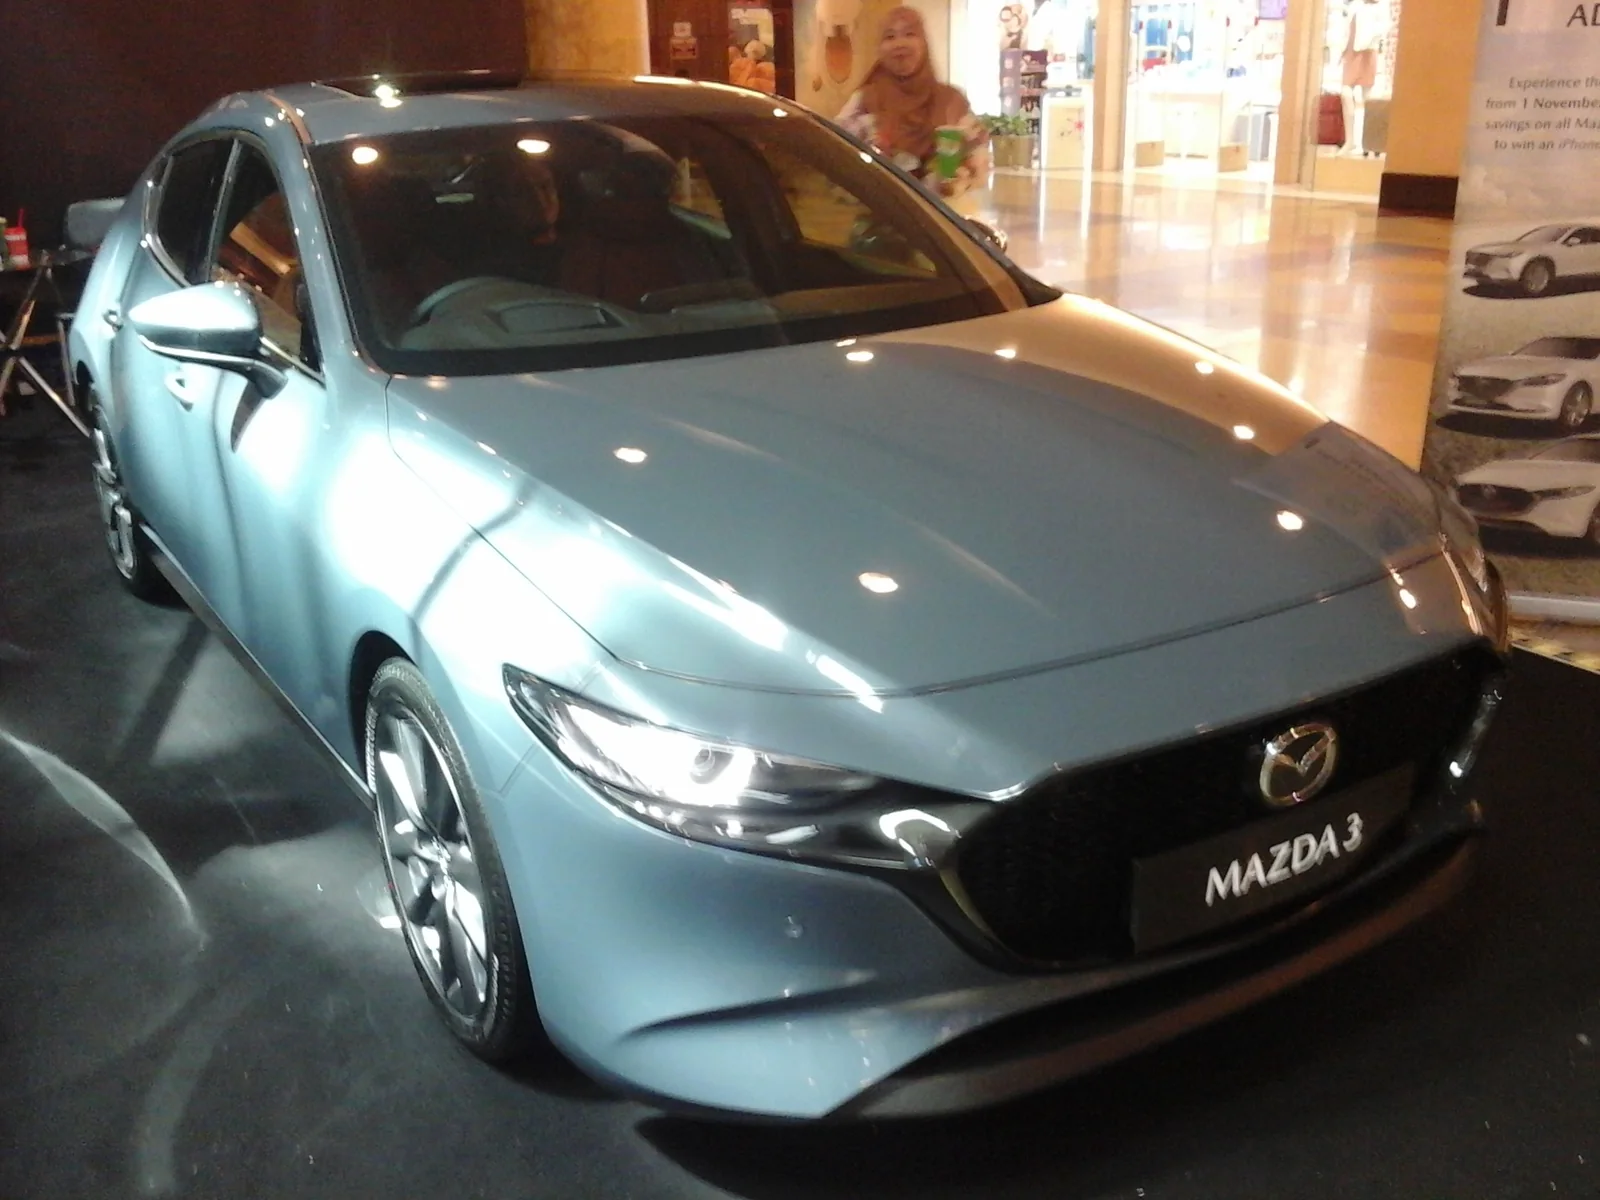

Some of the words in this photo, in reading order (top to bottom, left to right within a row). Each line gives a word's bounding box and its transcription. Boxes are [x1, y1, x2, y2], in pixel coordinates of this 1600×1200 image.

[1509, 77, 1581, 91] Experience
[1485, 97, 1516, 109] from
[1522, 98, 1528, 109] 1
[1533, 98, 1600, 109] Novembe
[1485, 119, 1530, 132] savings
[1535, 120, 1551, 130] on
[1555, 117, 1571, 129] all
[1494, 140, 1507, 149] to
[1511, 140, 1535, 150] win
[1538, 141, 1554, 150] an
[1205, 824, 1340, 906] MAZDA
[1343, 812, 1364, 852] 3
